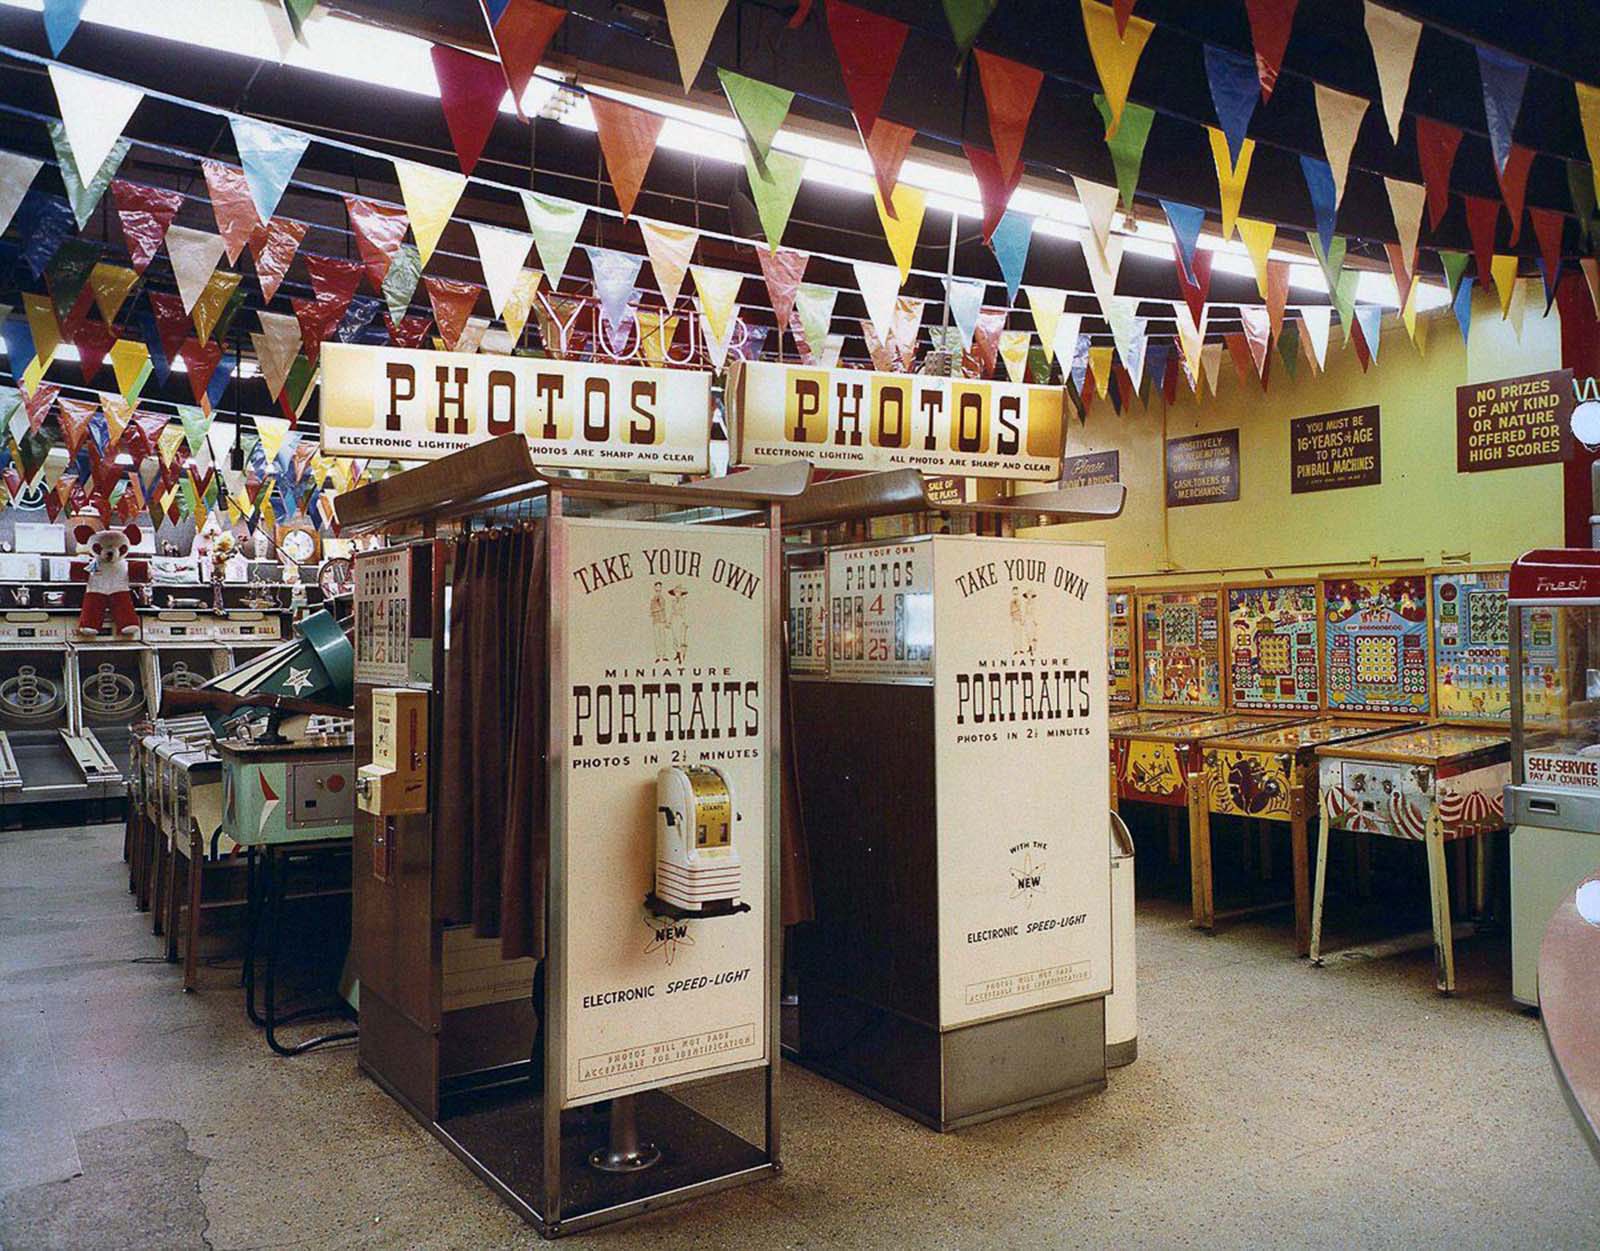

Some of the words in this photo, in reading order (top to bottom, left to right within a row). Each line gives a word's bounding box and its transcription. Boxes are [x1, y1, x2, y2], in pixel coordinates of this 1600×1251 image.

[1477, 388, 1496, 402] NO
[1501, 380, 1550, 399] PRIZES
[386, 362, 658, 446] PHOTOS
[1468, 405, 1486, 418] OF
[1490, 400, 1521, 416] ANY
[1524, 394, 1560, 411] KIND
[794, 378, 1021, 456] PHOTOS
[1307, 422, 1324, 433] YOU
[1327, 418, 1349, 431] MUST
[1352, 415, 1365, 426] BE
[1473, 420, 1491, 433] OR
[1499, 410, 1554, 429] NATURE
[1353, 427, 1374, 444] AGE
[1469, 429, 1526, 448] OFFERED
[1532, 425, 1560, 439] FOR
[339, 436, 412, 448] ELECTRONIC
[573, 448, 595, 457] ARE
[600, 450, 634, 460] SHARP
[638, 452, 659, 461] AND
[663, 454, 694, 462] CLEAR
[754, 447, 815, 459] ELECTRONIC
[819, 451, 865, 461] LIGHTING
[1316, 449, 1329, 461] TO
[1331, 446, 1354, 459] PLAY
[1470, 447, 1502, 462] HIGH
[1507, 440, 1560, 458] SCORES
[889, 455, 904, 464] ALL
[909, 456, 944, 466] PHOTOS
[949, 458, 967, 467] ARE
[971, 460, 999, 470] SHARP
[1003, 461, 1020, 470] AND
[1023, 463, 1051, 472] CLEAR
[1297, 461, 1331, 479] PINBALL
[1333, 456, 1374, 474] MACHINES
[927, 481, 944, 492] SALE
[868, 549, 891, 558] YOUR
[895, 546, 916, 555] OWN
[572, 552, 634, 595] TAKE
[642, 548, 702, 578] YOUR
[712, 558, 761, 600] OWN
[846, 560, 913, 591] PHOTOS
[955, 562, 999, 599] TAKE
[1004, 558, 1047, 583] YOUR
[1053, 566, 1089, 601] OWN
[1536, 575, 1588, 592] Fresh
[869, 594, 885, 616] 4
[605, 667, 732, 678] MINIATURE
[978, 658, 1070, 668] MINIATURE
[956, 670, 1090, 725] PORTRAITS
[573, 681, 760, 747] PORTRAITS
[957, 733, 998, 744] PHOTOS
[1007, 732, 1018, 740] IN
[1047, 728, 1091, 737] MINUTES
[572, 756, 631, 770] PHOTOS
[644, 754, 659, 765] IN
[700, 749, 760, 761] MINUTES
[1529, 757, 1598, 777] SELF-SERVICE
[1529, 771, 1545, 781] PAY
[1547, 773, 1557, 782] AT
[1560, 774, 1599, 788] COUNTER
[1009, 842, 1031, 855] WITH
[1033, 840, 1048, 851] THE
[1018, 876, 1041, 889] NEW
[655, 925, 687, 943] NEW
[967, 925, 1019, 944] ELECTRONIC
[1026, 913, 1088, 934] SPEED-LIGHT
[583, 985, 656, 1009] ELECTRONIC
[666, 968, 751, 995] SPEED-LIGHT
[584, 1058, 646, 1079] ACCEPTABLE
[675, 1036, 751, 1059] IDENTIFICATION
[607, 1048, 647, 1065] PHOTOS
[653, 1042, 676, 1054] WILL
[682, 1037, 701, 1050] NOT
